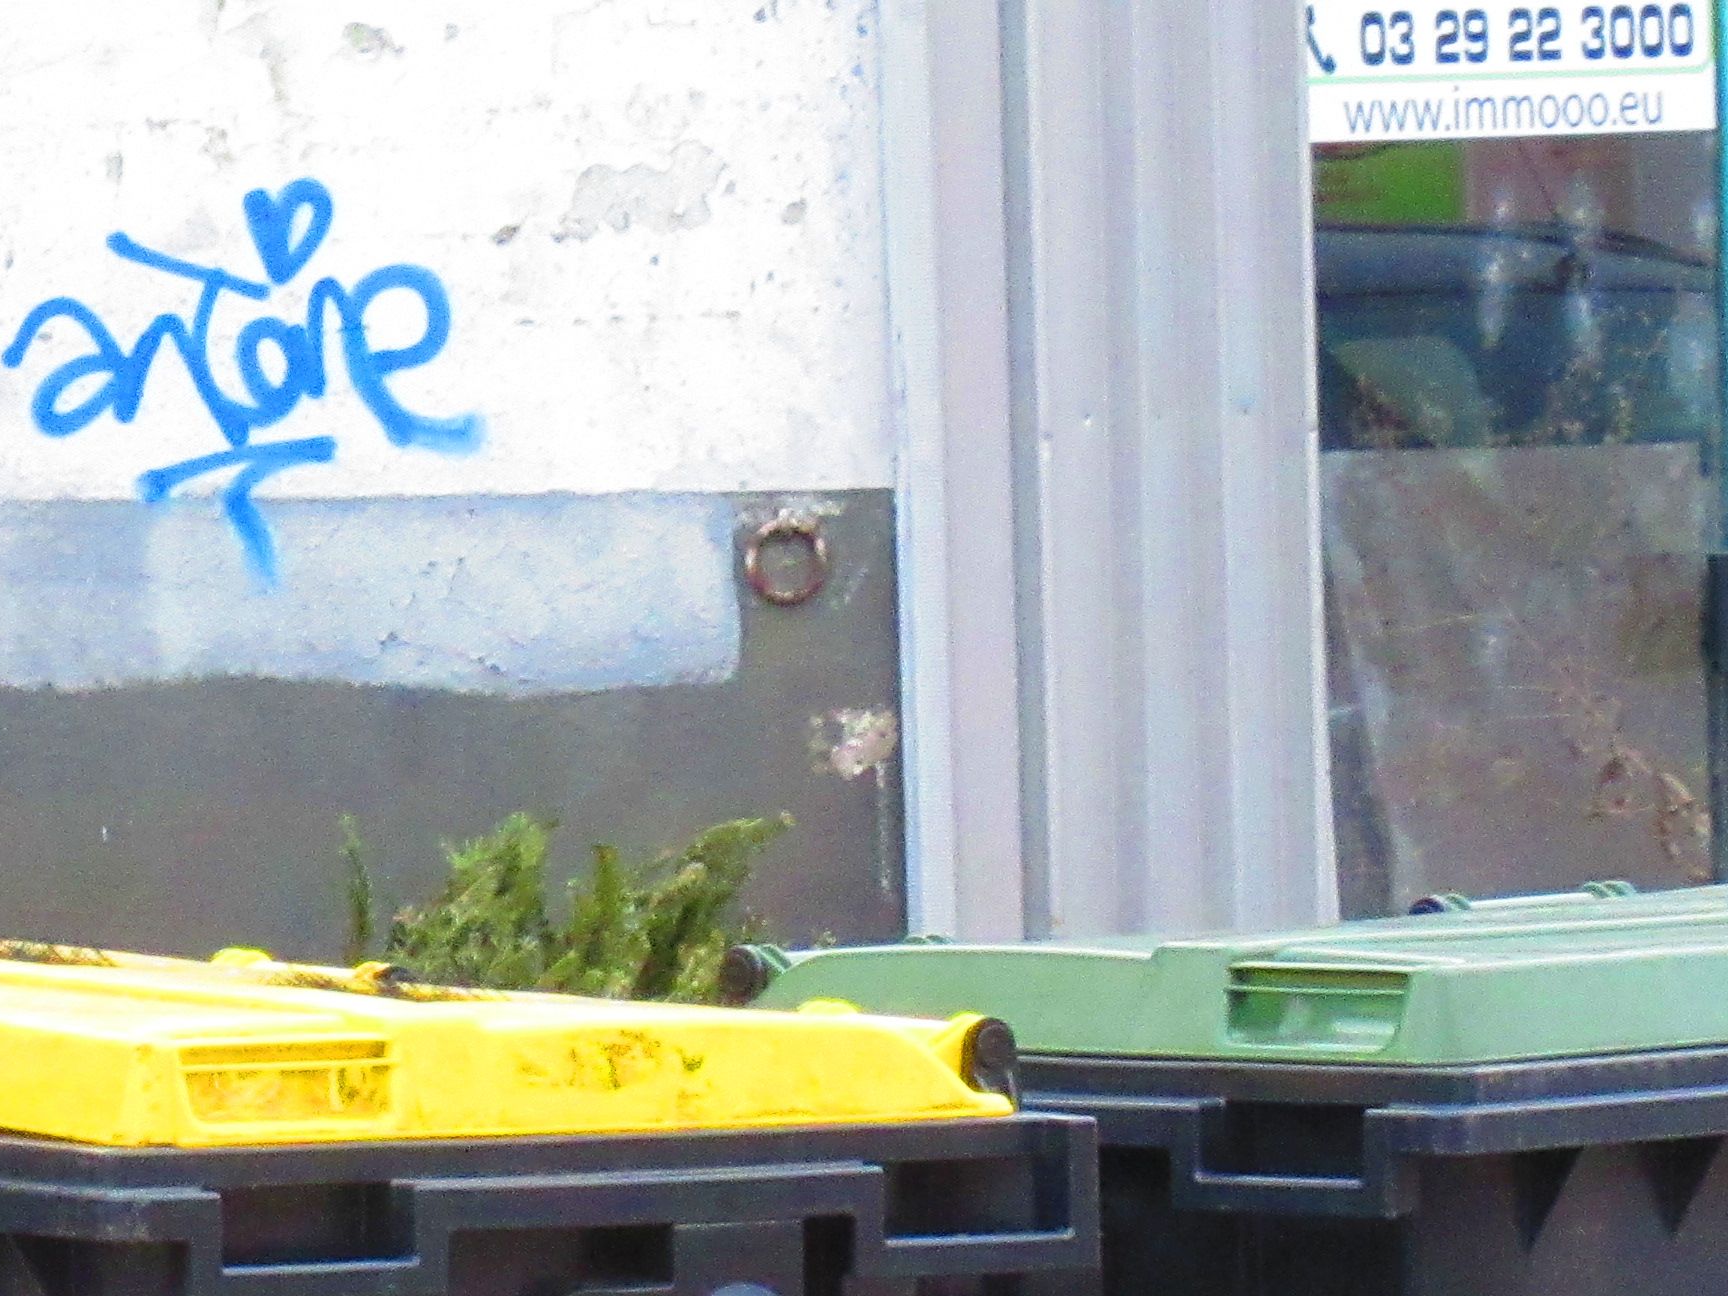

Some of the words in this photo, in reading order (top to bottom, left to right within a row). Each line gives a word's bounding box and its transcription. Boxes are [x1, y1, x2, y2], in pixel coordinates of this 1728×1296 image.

[1360, 11, 1415, 66] 03
[1435, 9, 1489, 64] 29
[1508, 7, 1562, 62] 22
[1581, 4, 1694, 60] 3000
[1344, 86, 1664, 134] www.immooo.eu
